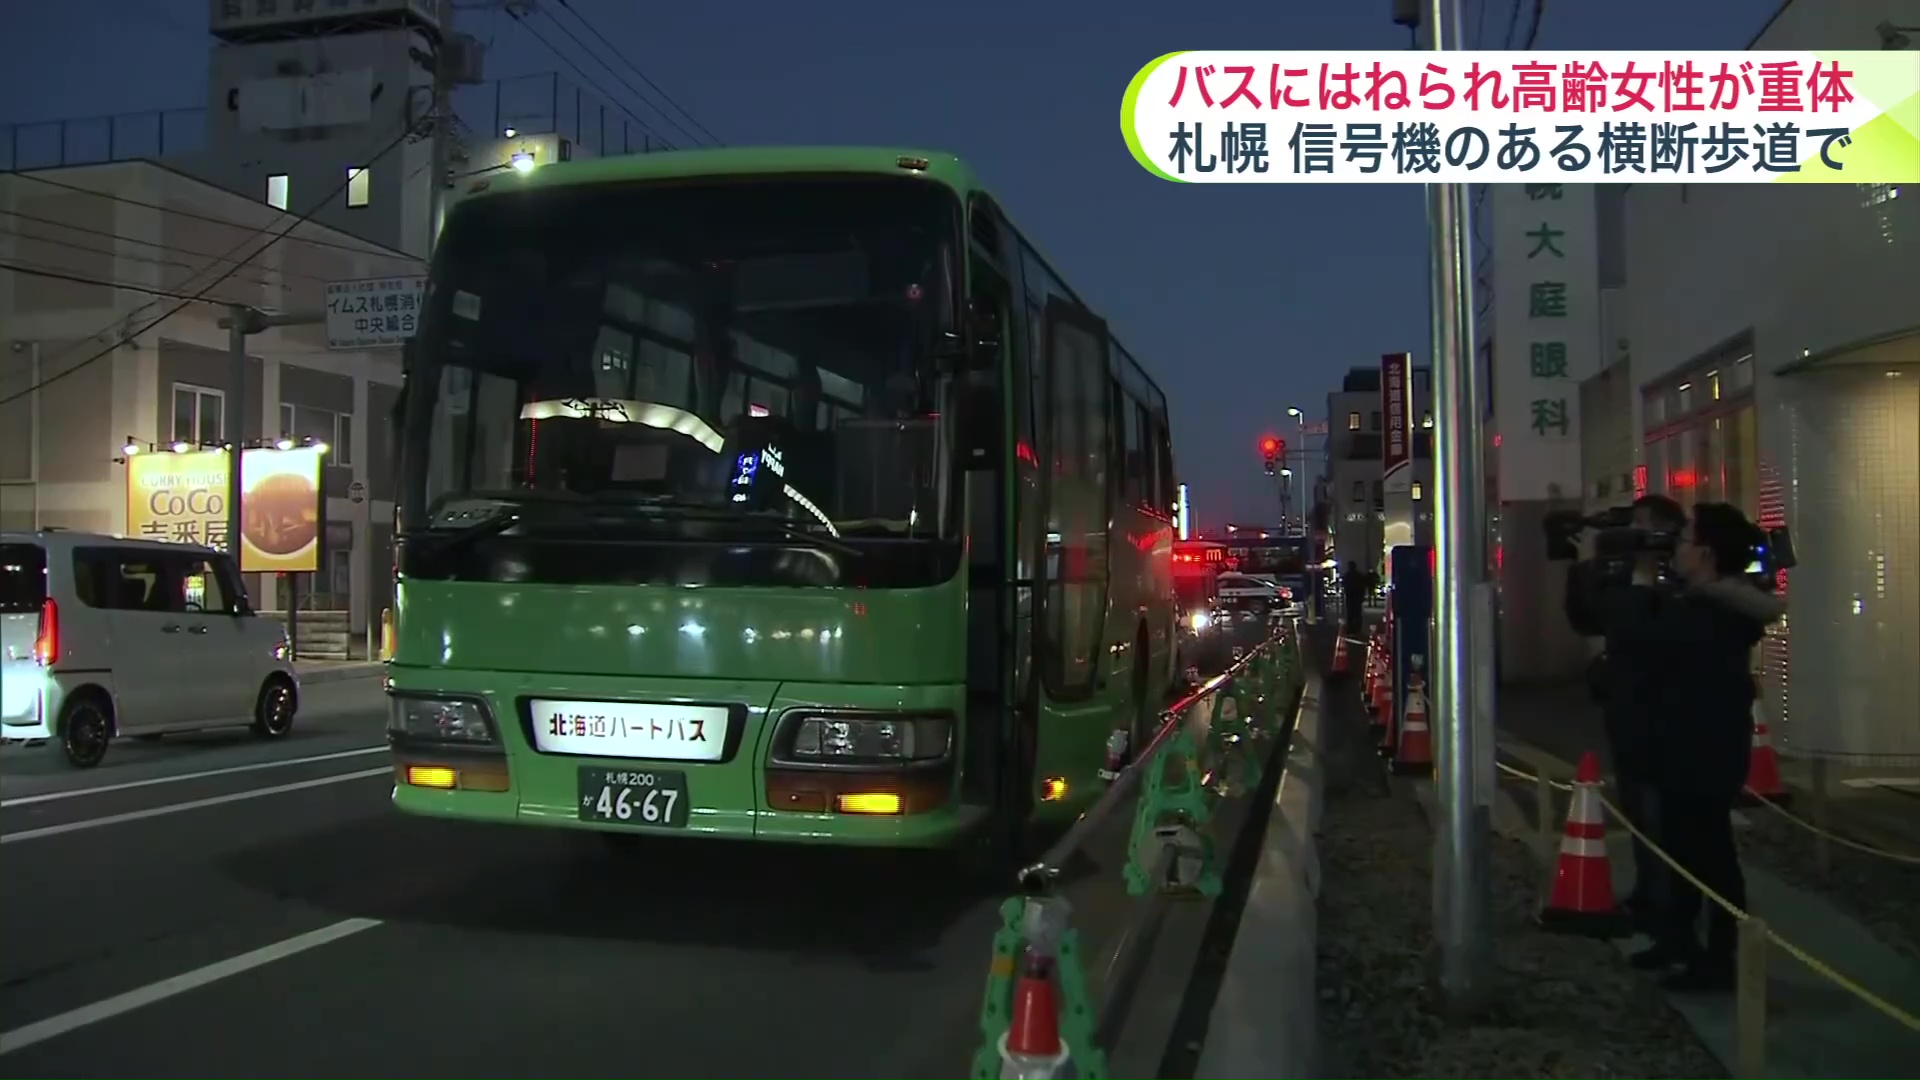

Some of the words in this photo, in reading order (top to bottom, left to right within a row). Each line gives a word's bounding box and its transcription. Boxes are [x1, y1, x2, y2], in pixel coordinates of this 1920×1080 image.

[142, 473, 182, 487] CURRY
[549, 713, 707, 742] 北海道ハートバス
[596, 786, 678, 823] 46-67
